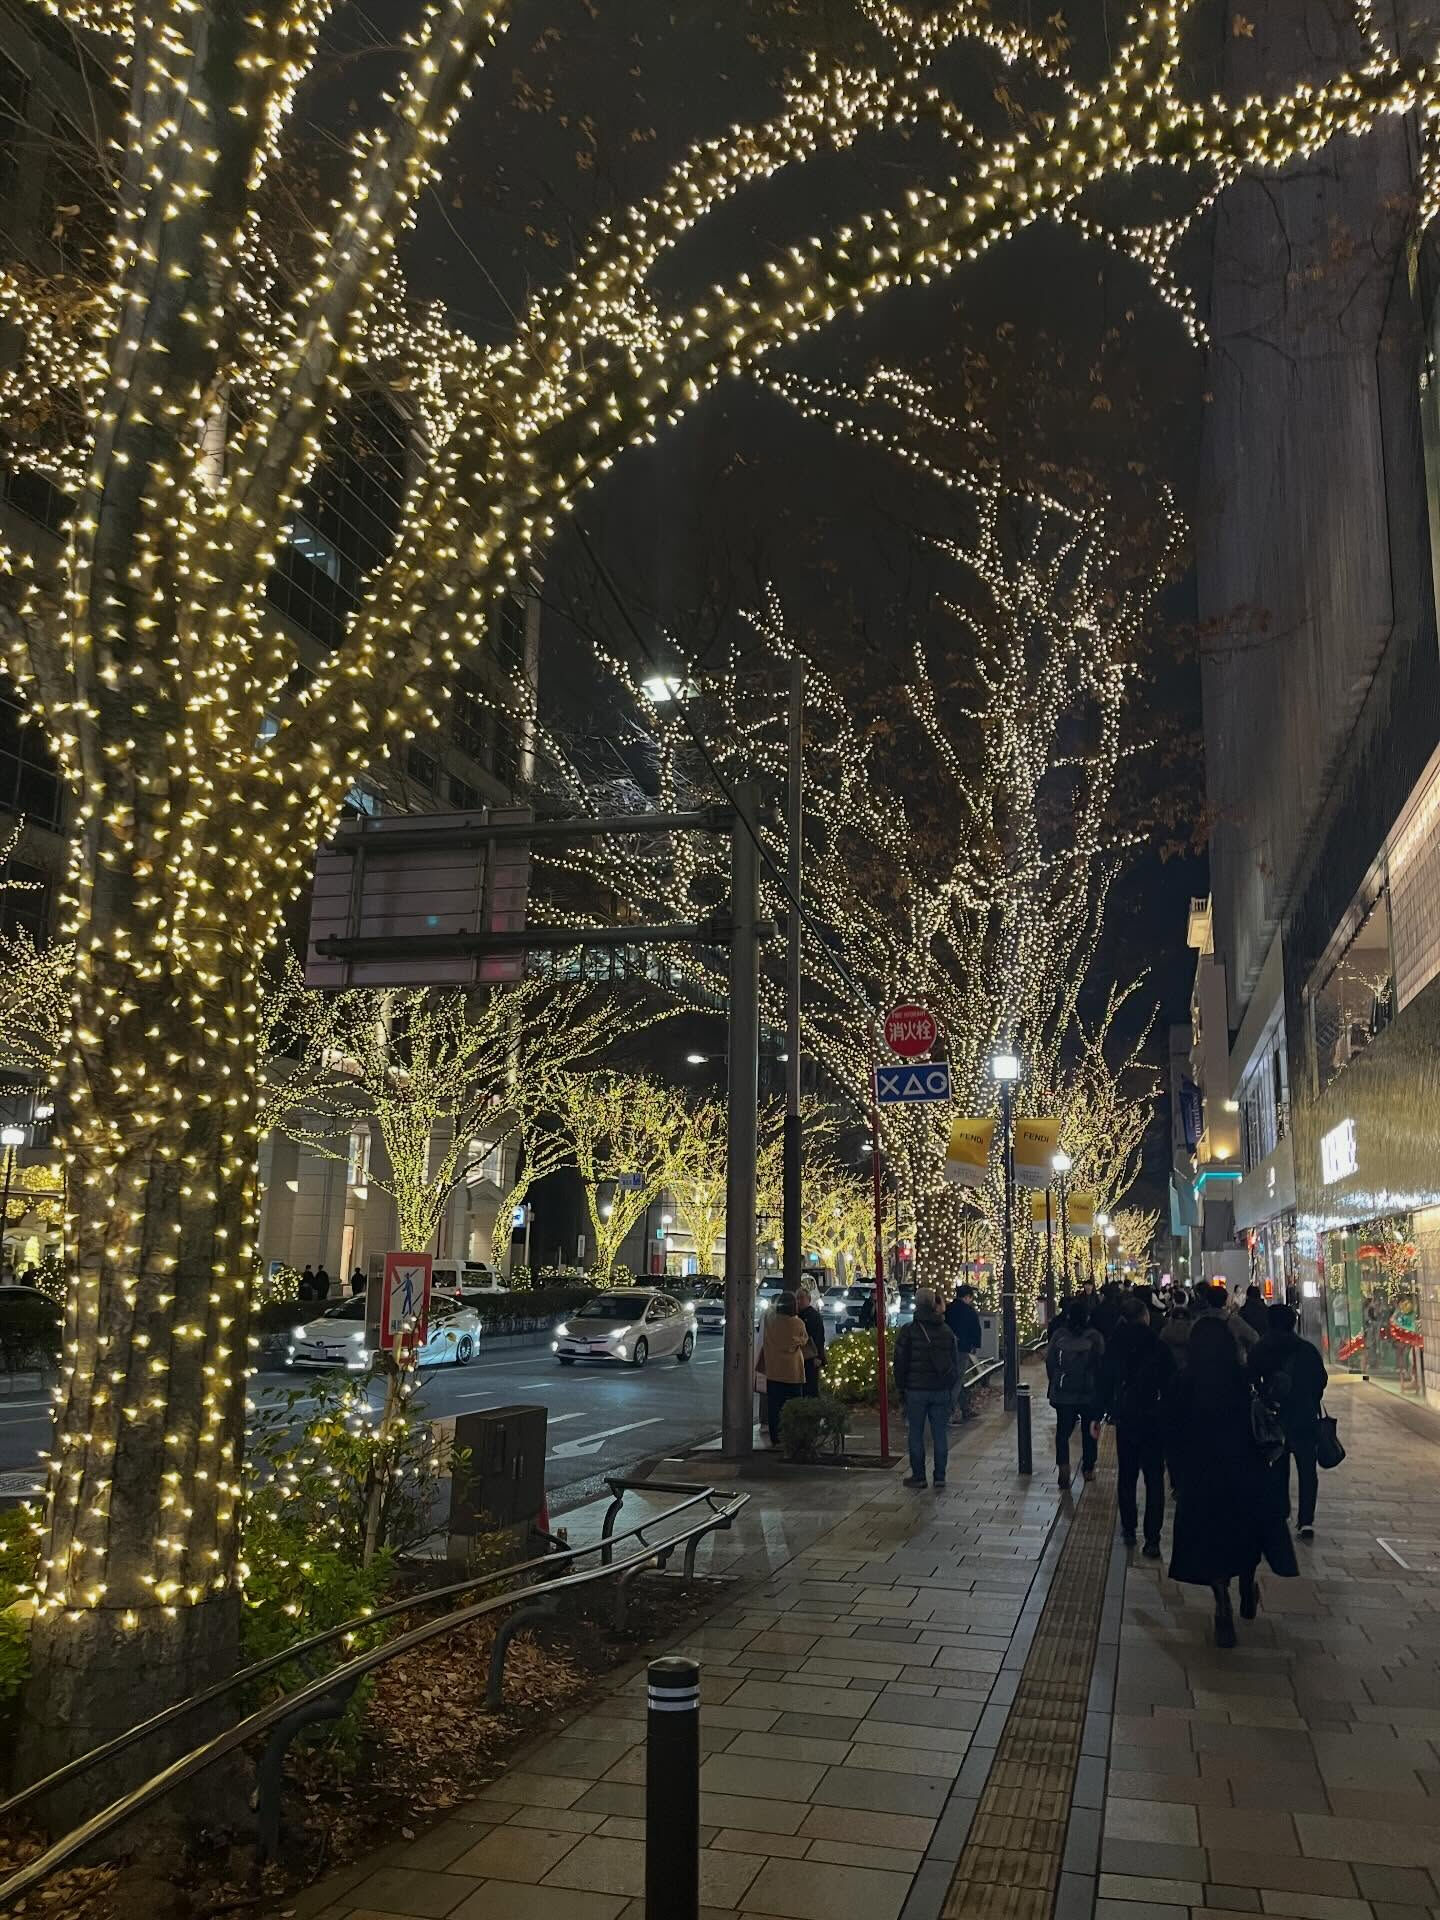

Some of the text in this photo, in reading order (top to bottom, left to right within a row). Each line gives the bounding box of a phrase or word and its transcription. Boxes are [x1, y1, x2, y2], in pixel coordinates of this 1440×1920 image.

[889, 1020, 932, 1042] 消火栓
[959, 1132, 984, 1145] FENDI
[1023, 1131, 1049, 1144] FENDI
